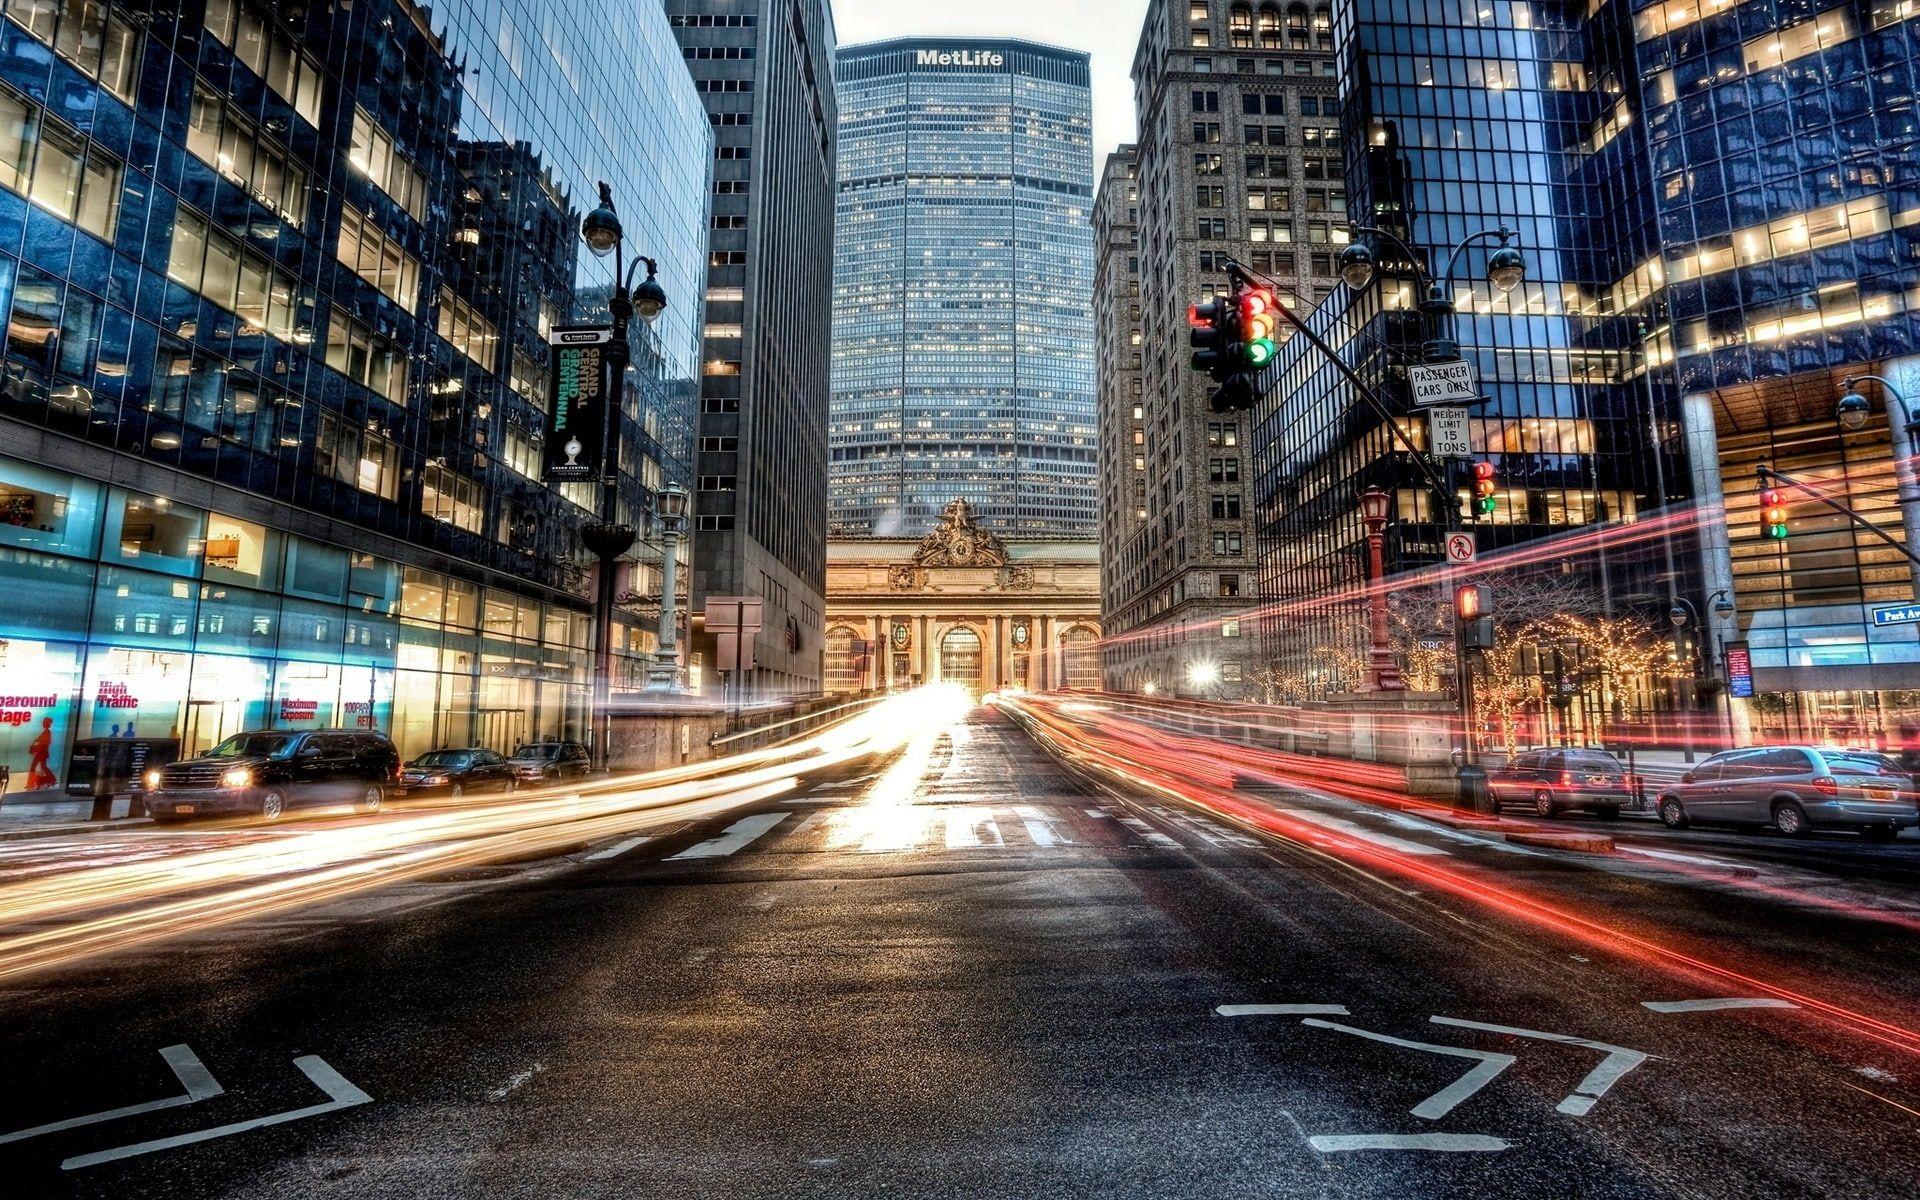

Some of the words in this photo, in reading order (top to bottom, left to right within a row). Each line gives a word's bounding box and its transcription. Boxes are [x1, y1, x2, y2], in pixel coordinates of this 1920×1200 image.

[917, 49, 1003, 66] MetLife
[568, 348, 580, 398] GRAND
[577, 347, 590, 409] CENTRAL
[588, 347, 599, 398] GRAND
[1414, 366, 1468, 382] PASSENGER
[554, 349, 570, 432] CENTENNIAL
[1417, 384, 1442, 397] CARS
[1446, 380, 1469, 393] ONLY
[1432, 410, 1465, 419] WEIGHT
[1438, 420, 1461, 429] LIMIT
[1444, 430, 1457, 440] 15
[1437, 442, 1467, 453] TONS
[1884, 611, 1906, 621] Park
[491, 665, 506, 673] 100
[98, 681, 128, 697] High
[98, 695, 139, 709] Traffic
[281, 697, 318, 710] Maximum
[280, 709, 315, 722] Exposure
[357, 715, 378, 727] RETIL
